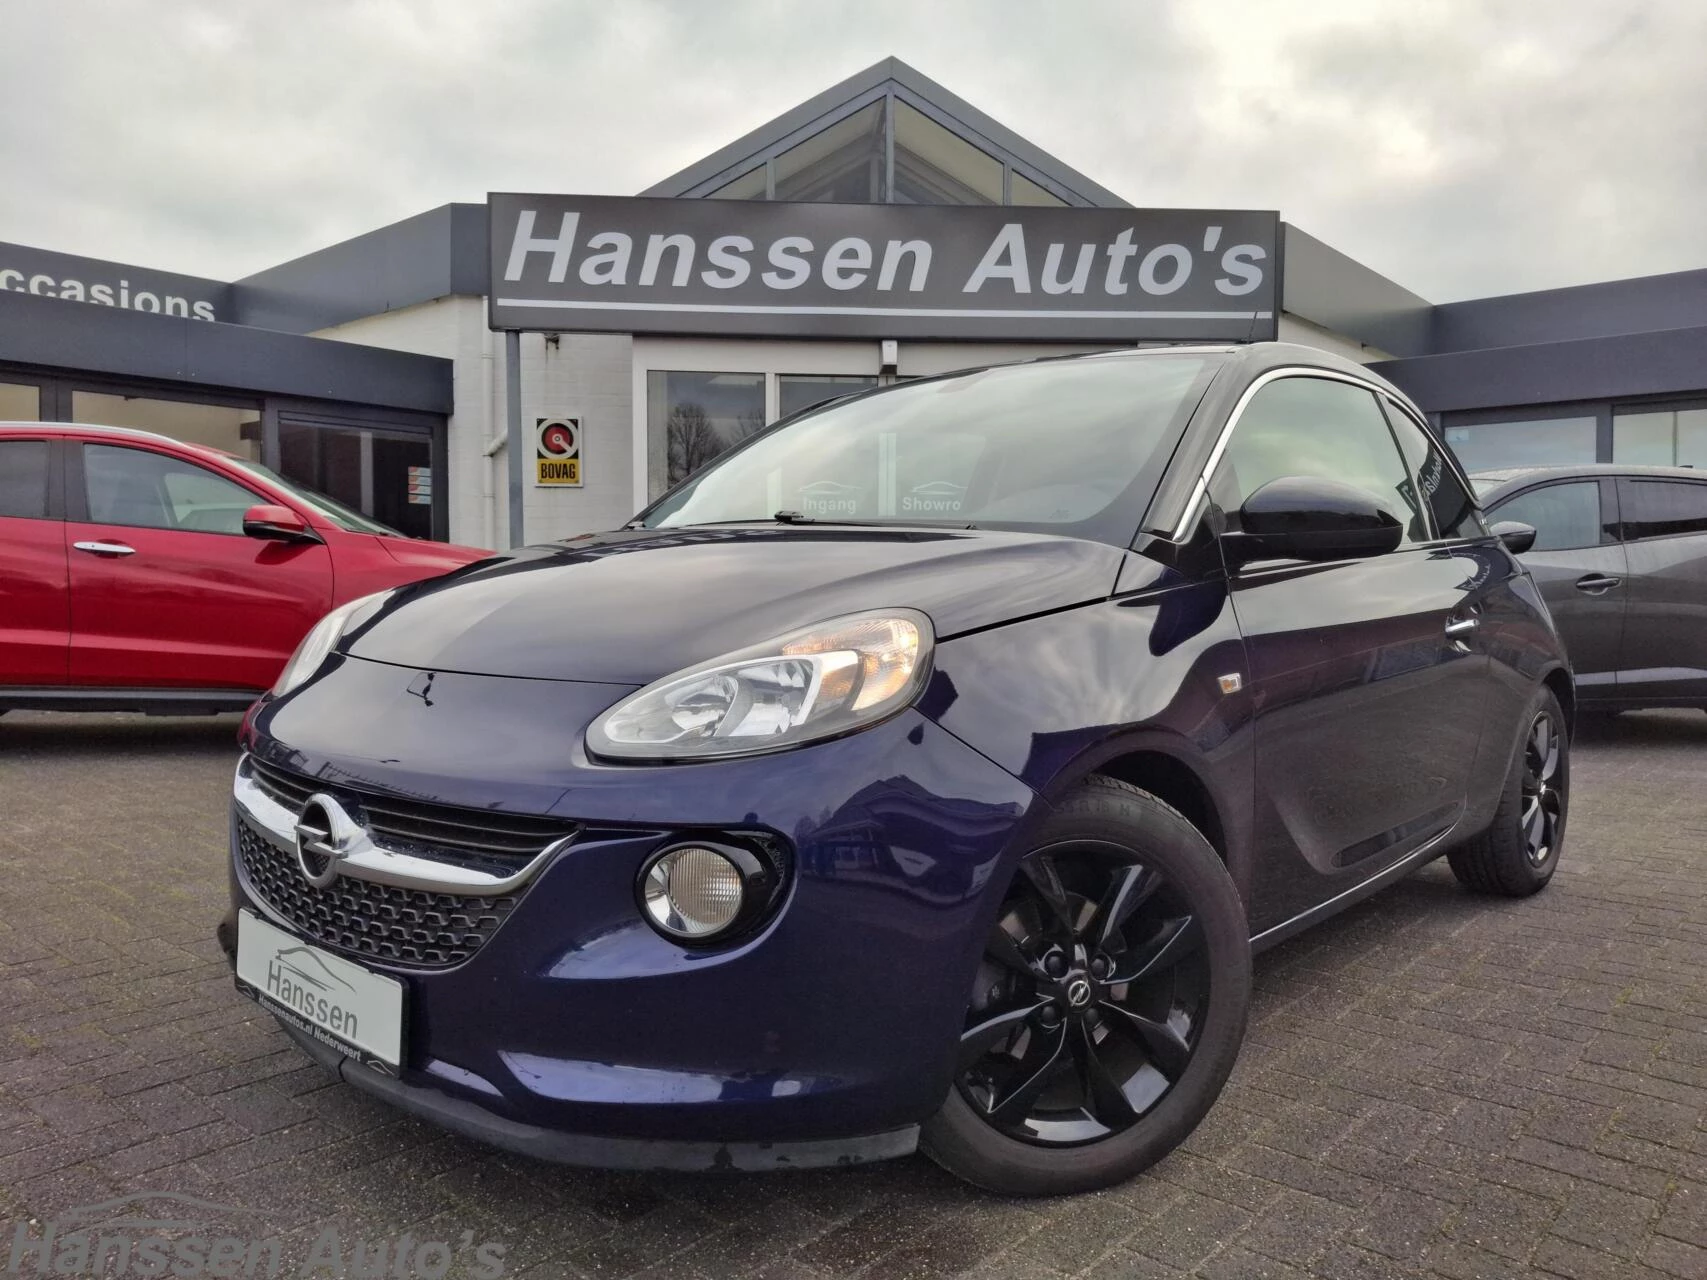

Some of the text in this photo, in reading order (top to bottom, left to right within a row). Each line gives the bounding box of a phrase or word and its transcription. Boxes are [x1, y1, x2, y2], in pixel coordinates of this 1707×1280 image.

[504, 210, 1267, 296] Hanssen Auto's
[541, 463, 576, 479] BOVAG
[802, 497, 857, 513] Ingang
[902, 497, 961, 512] Showro
[267, 960, 358, 1039] Hanssen
[314, 1027, 361, 1061] Nederweert
